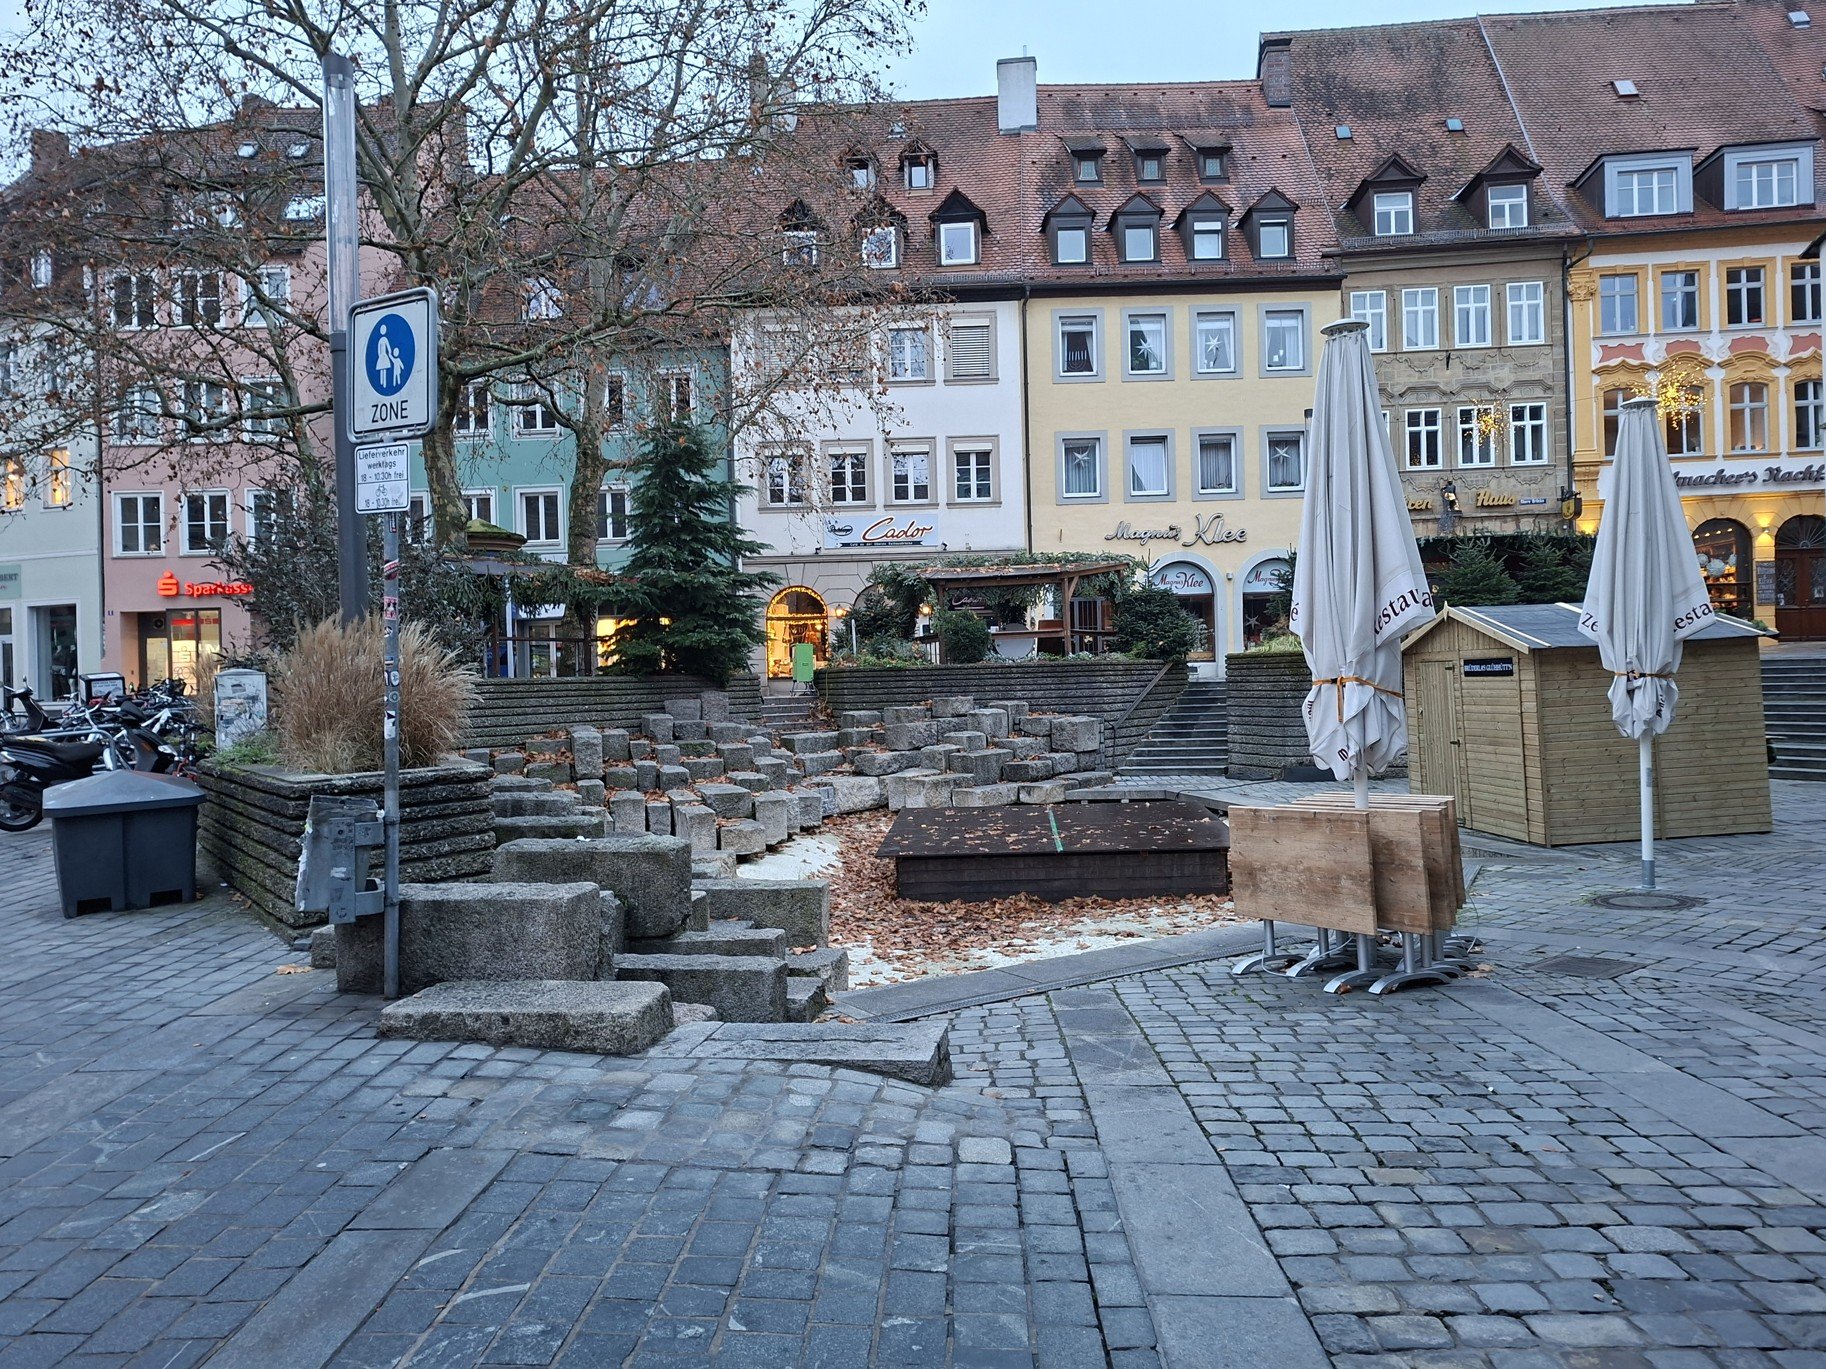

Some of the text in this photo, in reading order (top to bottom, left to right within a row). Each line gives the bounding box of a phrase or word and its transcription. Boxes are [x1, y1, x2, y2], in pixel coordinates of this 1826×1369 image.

[371, 399, 409, 424] ZONE
[358, 447, 406, 461] Lieferverkehr
[366, 460, 397, 471] werktags
[393, 470, 405, 479] frei
[1475, 488, 1516, 508] Haus
[861, 516, 934, 541] Cador
[1104, 512, 1248, 547] Magnus Klee
[1153, 571, 1204, 589] Magnus Klee
